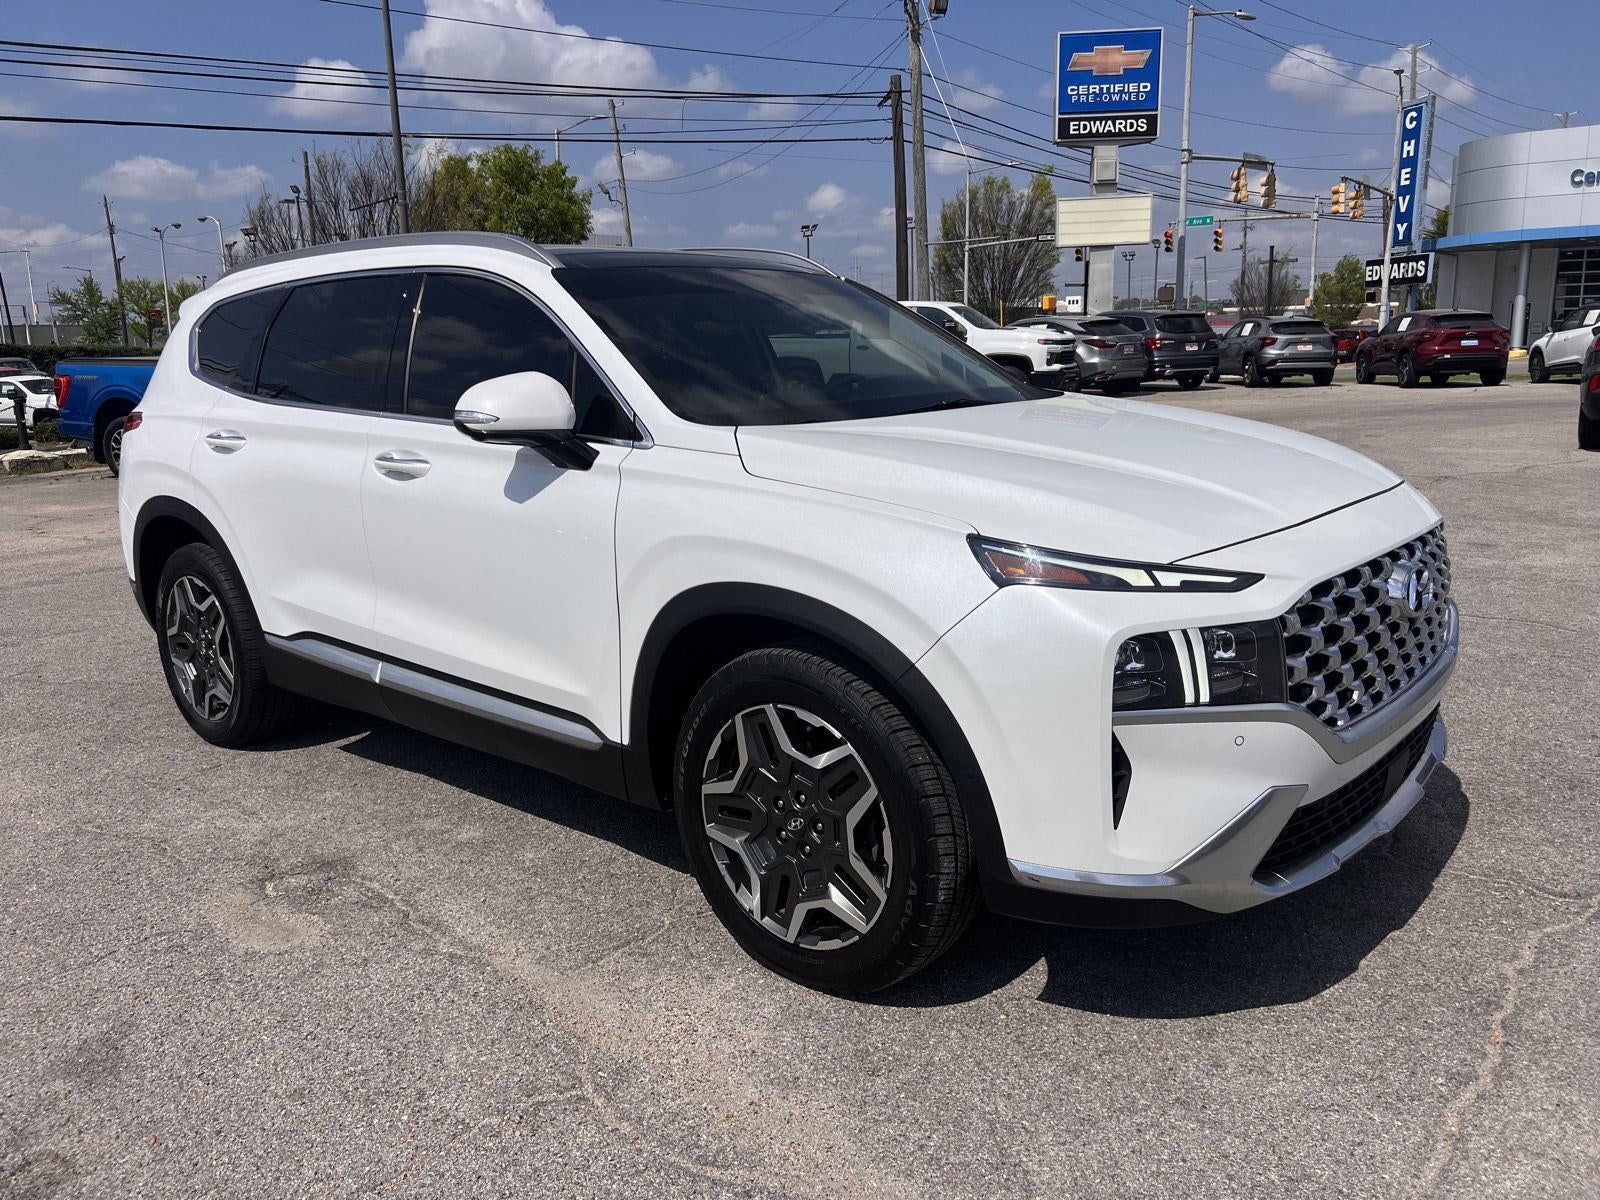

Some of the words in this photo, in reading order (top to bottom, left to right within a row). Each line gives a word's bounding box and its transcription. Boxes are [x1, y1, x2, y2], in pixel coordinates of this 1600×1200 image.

[1067, 82, 1151, 95] CERTIFIED
[1071, 92, 1146, 103] PRE-OWNED
[1069, 118, 1148, 135] EDWARDS
[1396, 111, 1418, 241] CHEVY
